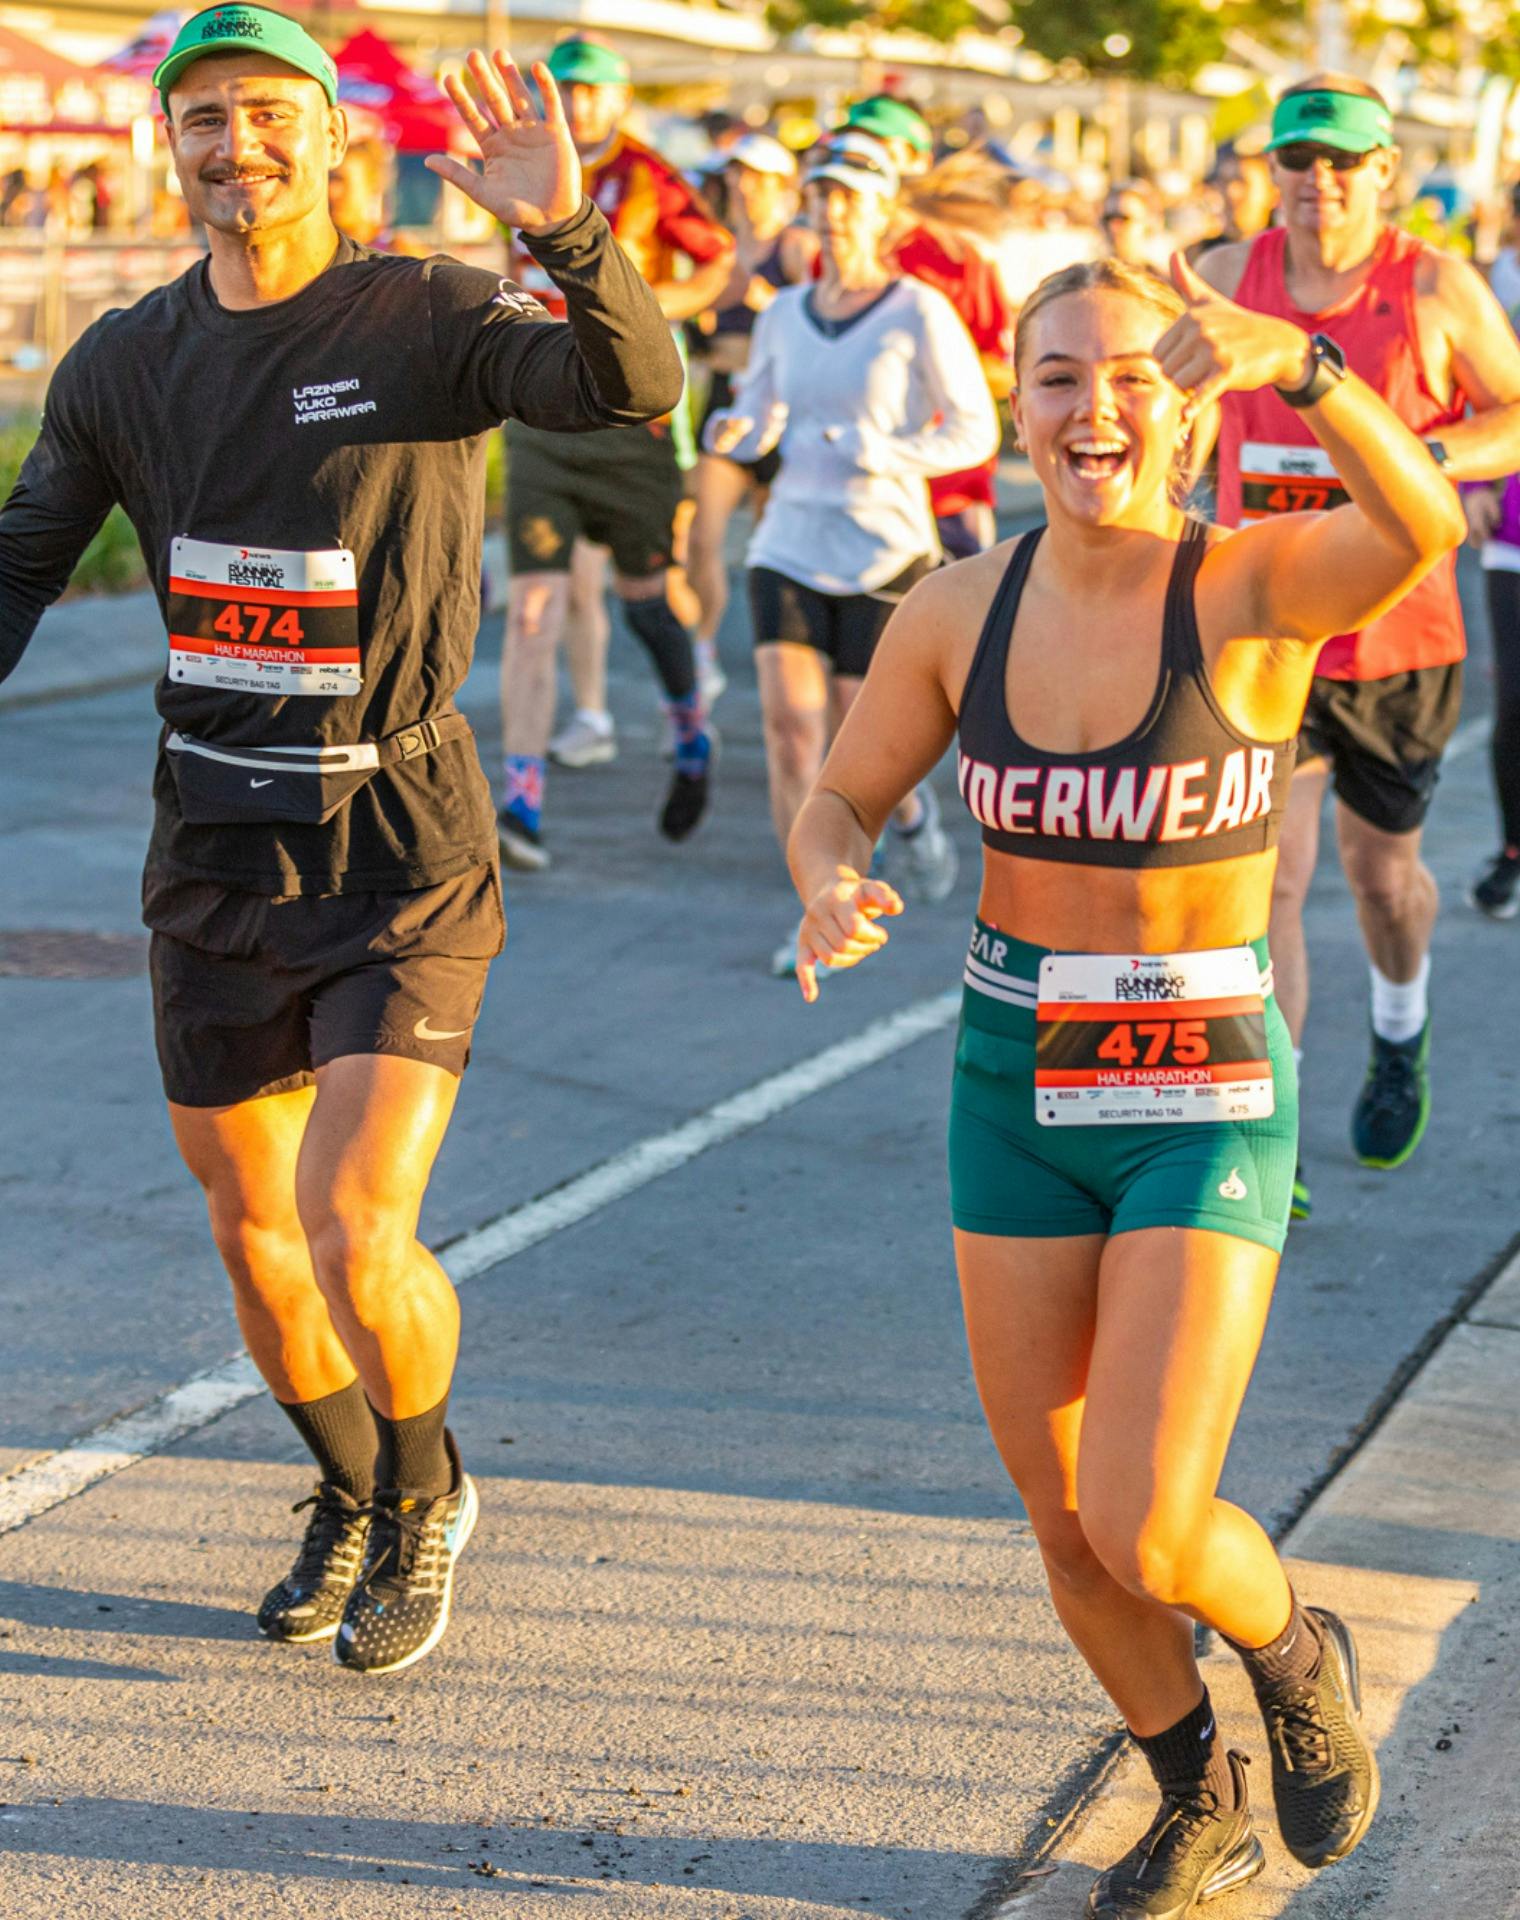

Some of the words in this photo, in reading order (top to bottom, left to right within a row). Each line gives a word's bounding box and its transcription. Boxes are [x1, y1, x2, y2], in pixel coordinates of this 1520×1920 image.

[293, 378, 360, 399] LAZINSKI
[294, 396, 337, 412] VUKO
[295, 400, 377, 424] HARAWIRA
[1267, 487, 1329, 512] 477
[229, 564, 285, 579] RUNNING
[229, 574, 285, 588] FESTIVAL
[213, 603, 305, 646] 474
[214, 643, 241, 658] HALF
[242, 647, 305, 663] MARATHON
[215, 674, 249, 687] SECURITY
[250, 678, 265, 688] BAG
[266, 680, 281, 690] TAG
[319, 682, 338, 691] 474
[1115, 976, 1185, 992] RUNNING
[1115, 987, 1186, 1001] FESTIVAL
[1097, 1020, 1210, 1067] 475
[1097, 1071, 1133, 1086] HALF
[1134, 1069, 1213, 1085] MARATHON
[1098, 1109, 1143, 1119] SECURITY
[1145, 1108, 1164, 1118] BAG
[1165, 1107, 1183, 1117] TAG
[1228, 1104, 1249, 1114] 475
